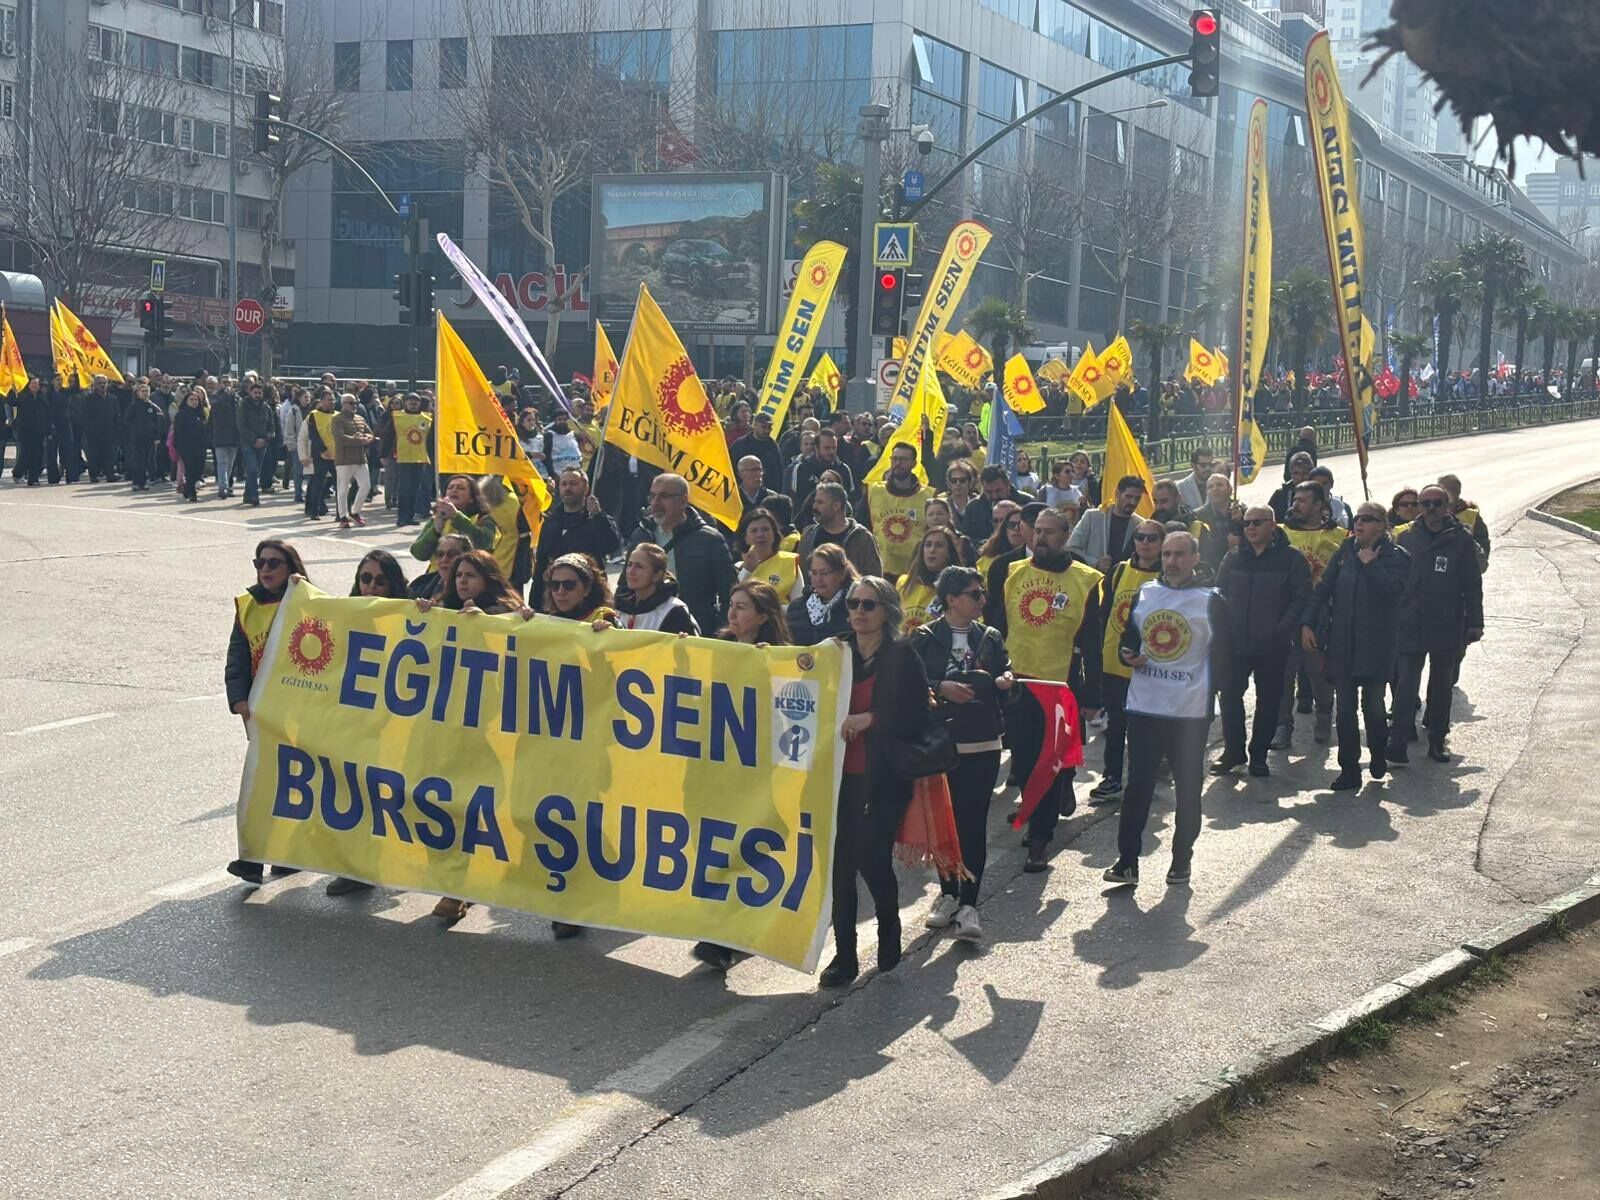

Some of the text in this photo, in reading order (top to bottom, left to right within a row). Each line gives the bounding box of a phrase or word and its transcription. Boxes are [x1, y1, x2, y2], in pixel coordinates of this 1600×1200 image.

[494, 264, 589, 311] ACİL
[236, 307, 261, 325] DUR
[786, 298, 817, 354] SEN
[898, 258, 963, 401] EĞİTİM SEN
[454, 426, 519, 460] EĞİT
[619, 406, 736, 503] EĞİİM SEN
[339, 619, 758, 768] EĞİTİM SEN
[1169, 670, 1193, 681] SEN
[775, 696, 816, 713] KESK
[272, 743, 814, 912] BURSA ŞUBESİ
